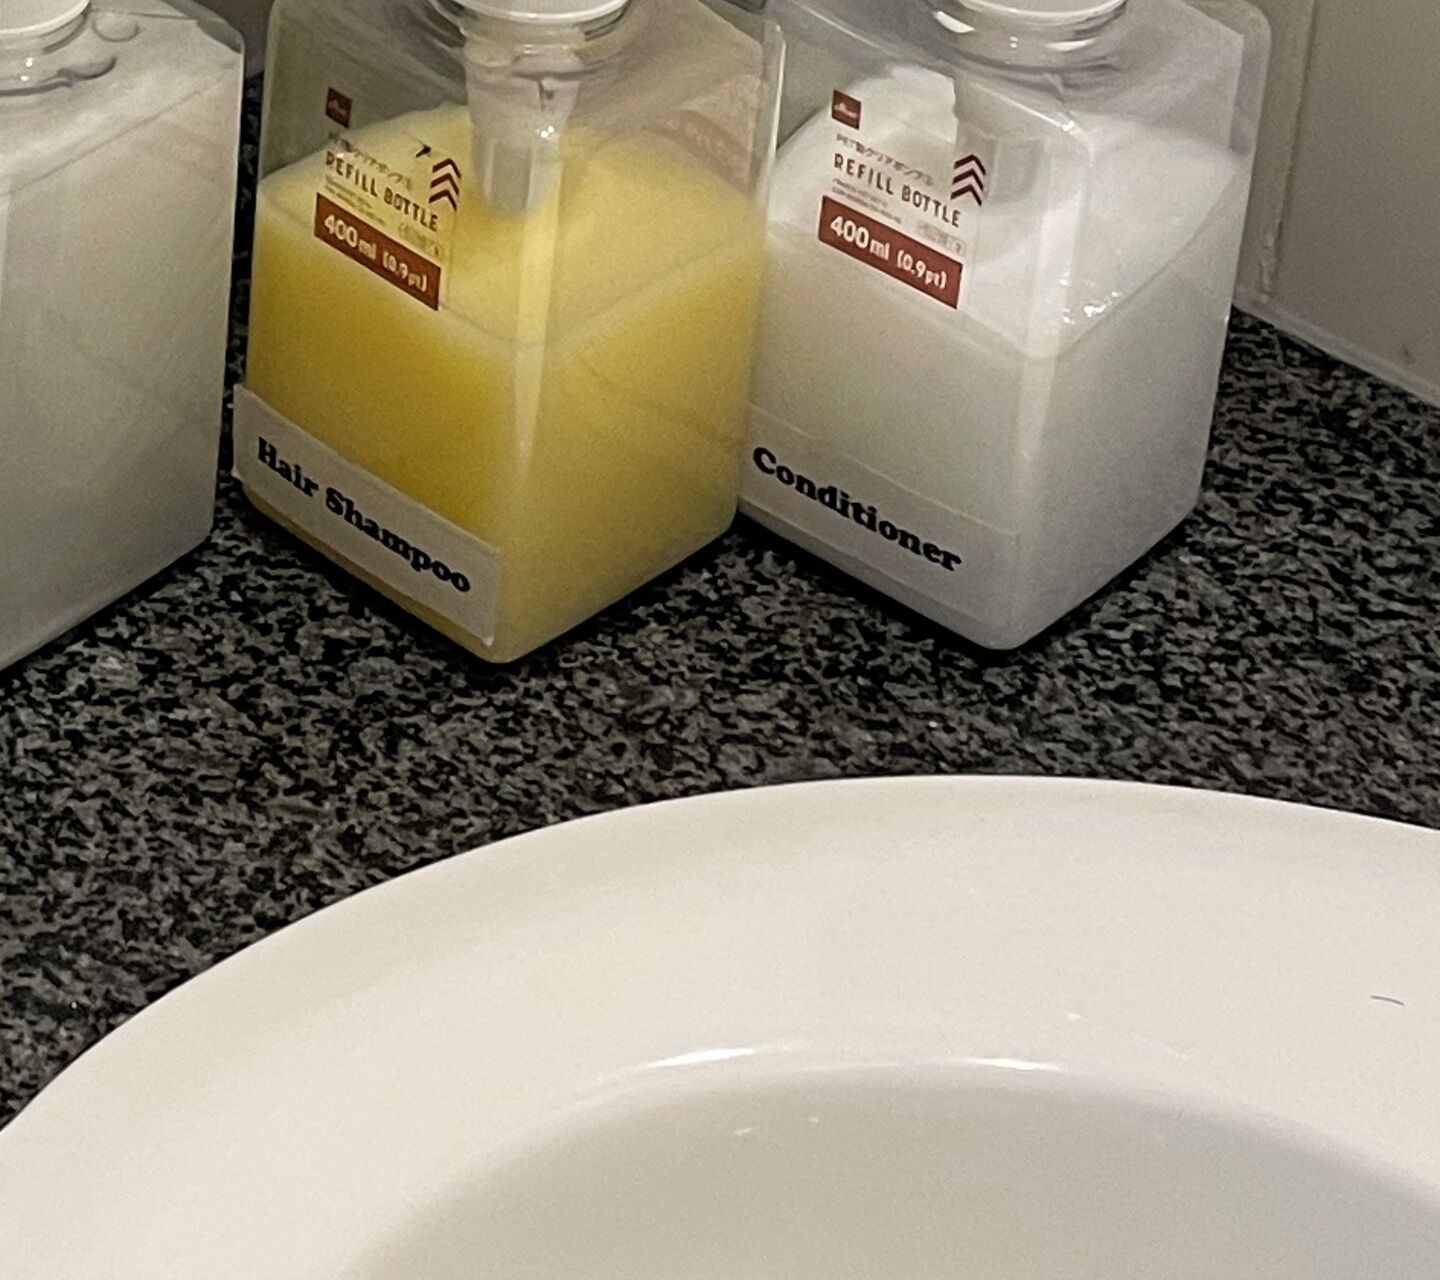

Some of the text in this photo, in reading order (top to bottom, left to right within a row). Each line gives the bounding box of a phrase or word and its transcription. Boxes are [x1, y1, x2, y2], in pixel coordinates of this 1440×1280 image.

[325, 150, 378, 198] REFILL
[384, 188, 438, 232] BOTTLE
[834, 153, 894, 195] REFILL
[901, 184, 961, 228] BOTTLE
[897, 248, 947, 290] (0.9pt)
[258, 435, 471, 593] Hair Shampoo
[753, 446, 962, 572] Conditioner
